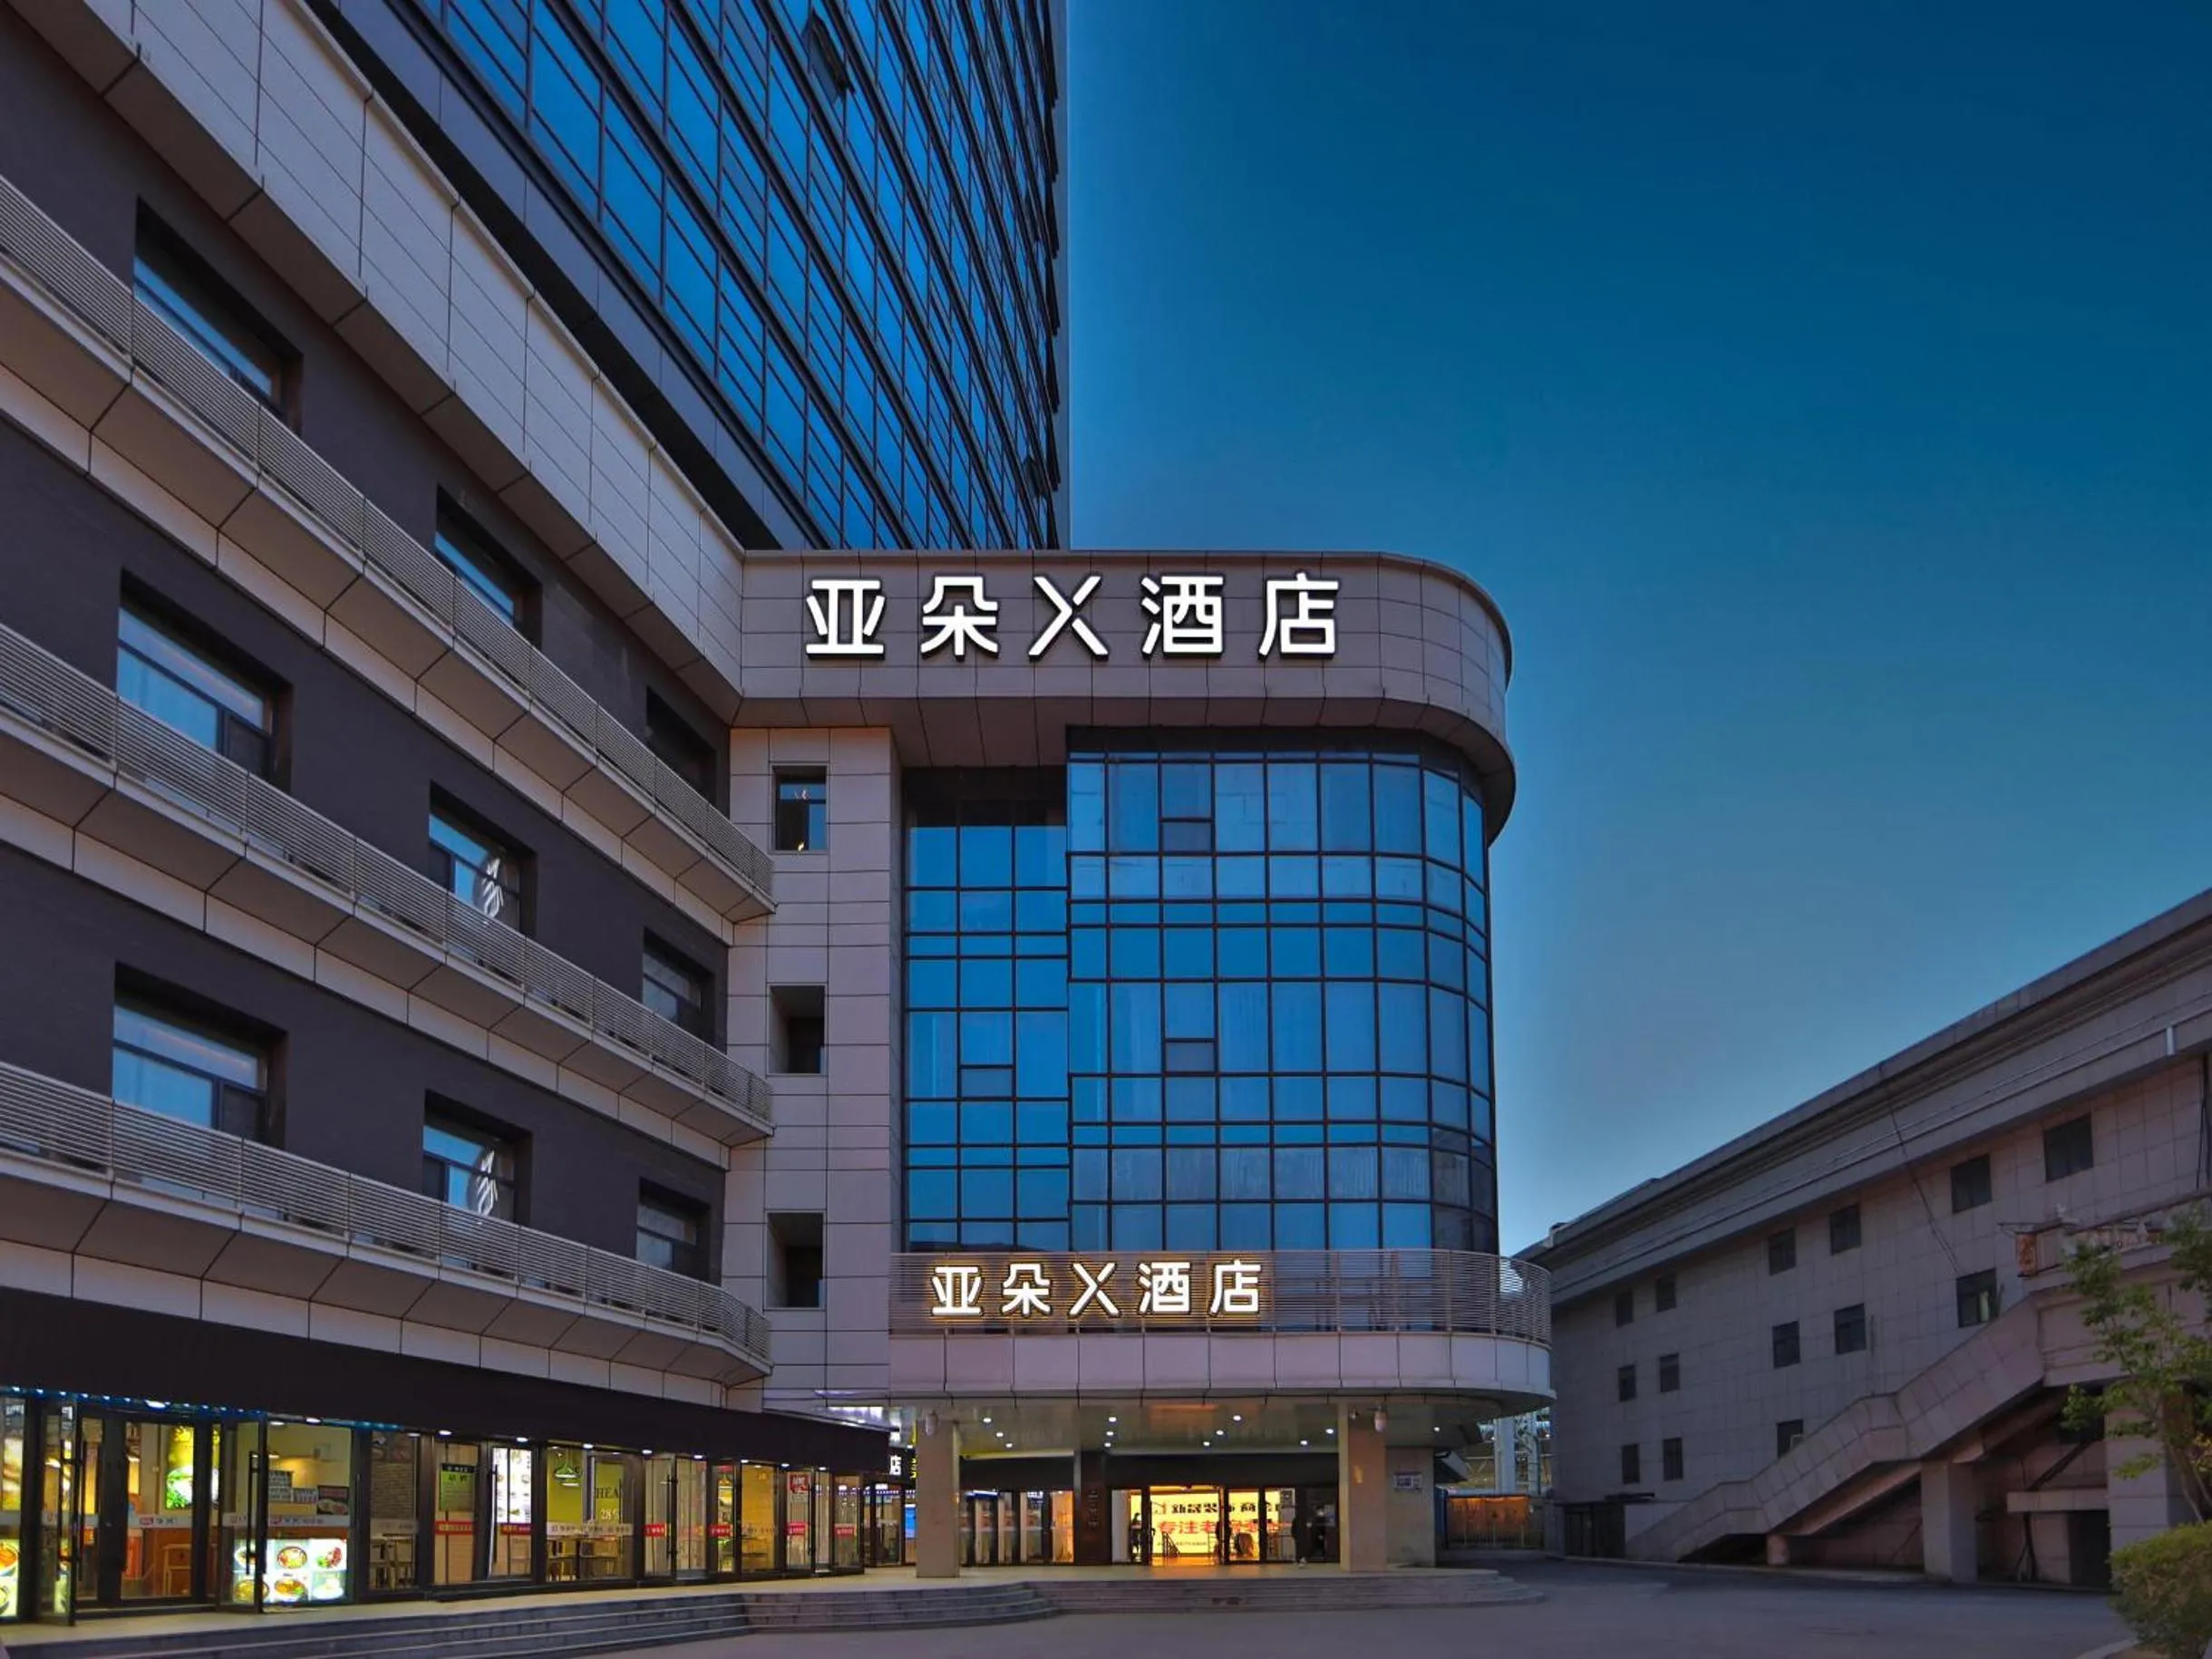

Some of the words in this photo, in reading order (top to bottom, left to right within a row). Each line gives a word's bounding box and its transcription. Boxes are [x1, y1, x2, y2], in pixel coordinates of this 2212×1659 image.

[807, 573, 1338, 655] 亚朵X酒店
[933, 1260, 1260, 1314] 亚朵X酒店
